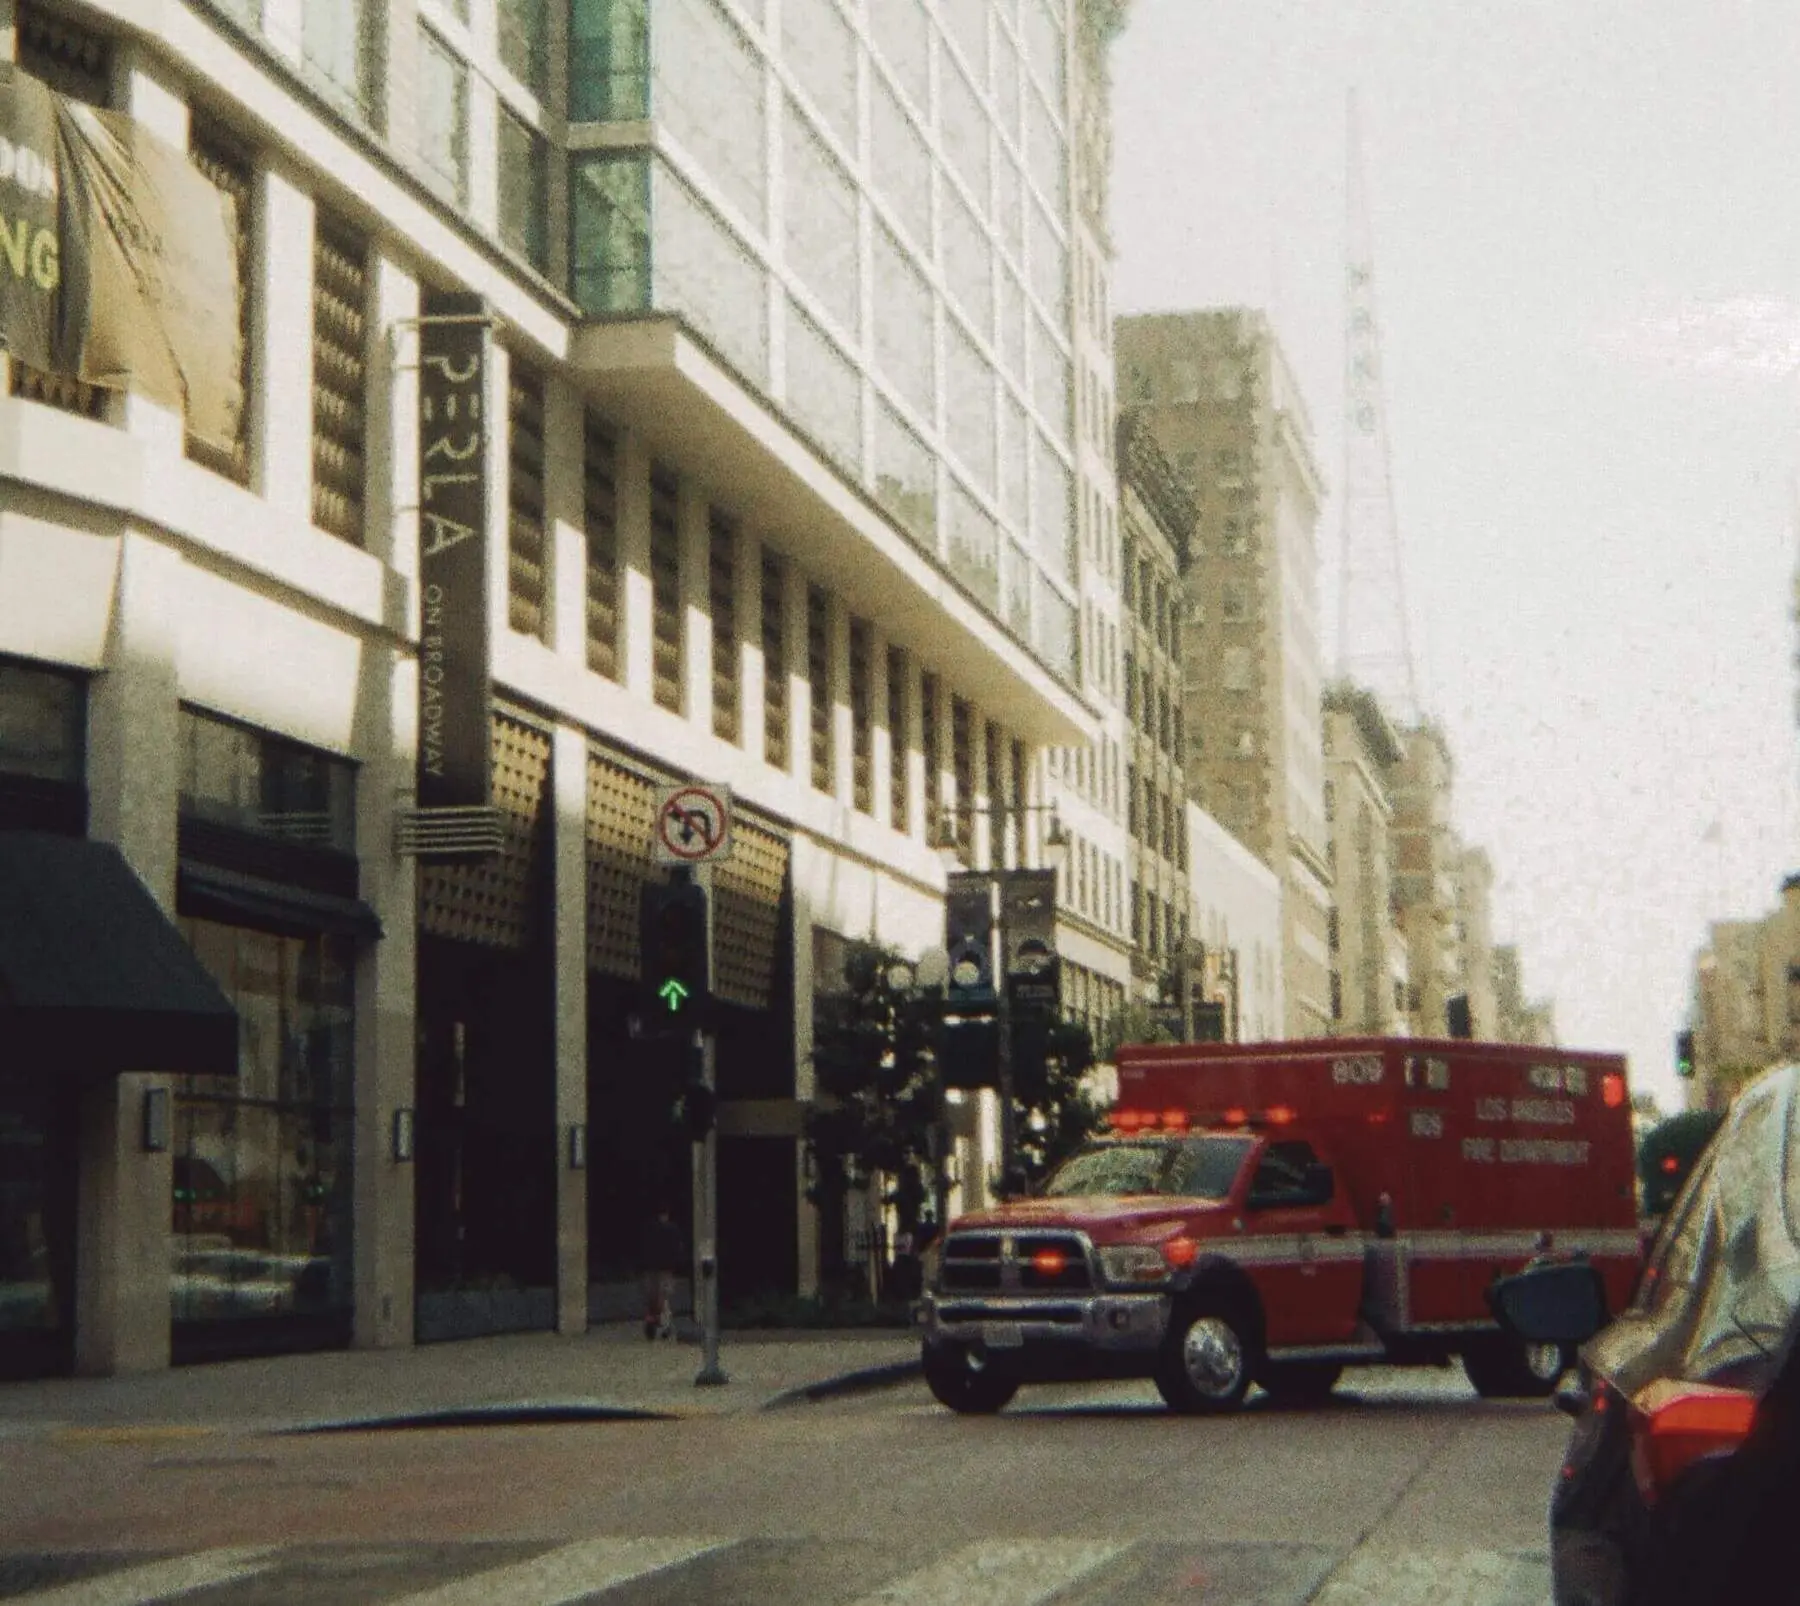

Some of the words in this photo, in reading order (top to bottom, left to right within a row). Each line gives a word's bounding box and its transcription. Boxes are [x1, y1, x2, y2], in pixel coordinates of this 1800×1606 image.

[424, 353, 480, 557] PERLA
[423, 583, 444, 626] ON
[423, 634, 445, 777] BROADWAY
[1475, 1098, 1507, 1122] LOS
[1511, 1099, 1575, 1125] ANGELES
